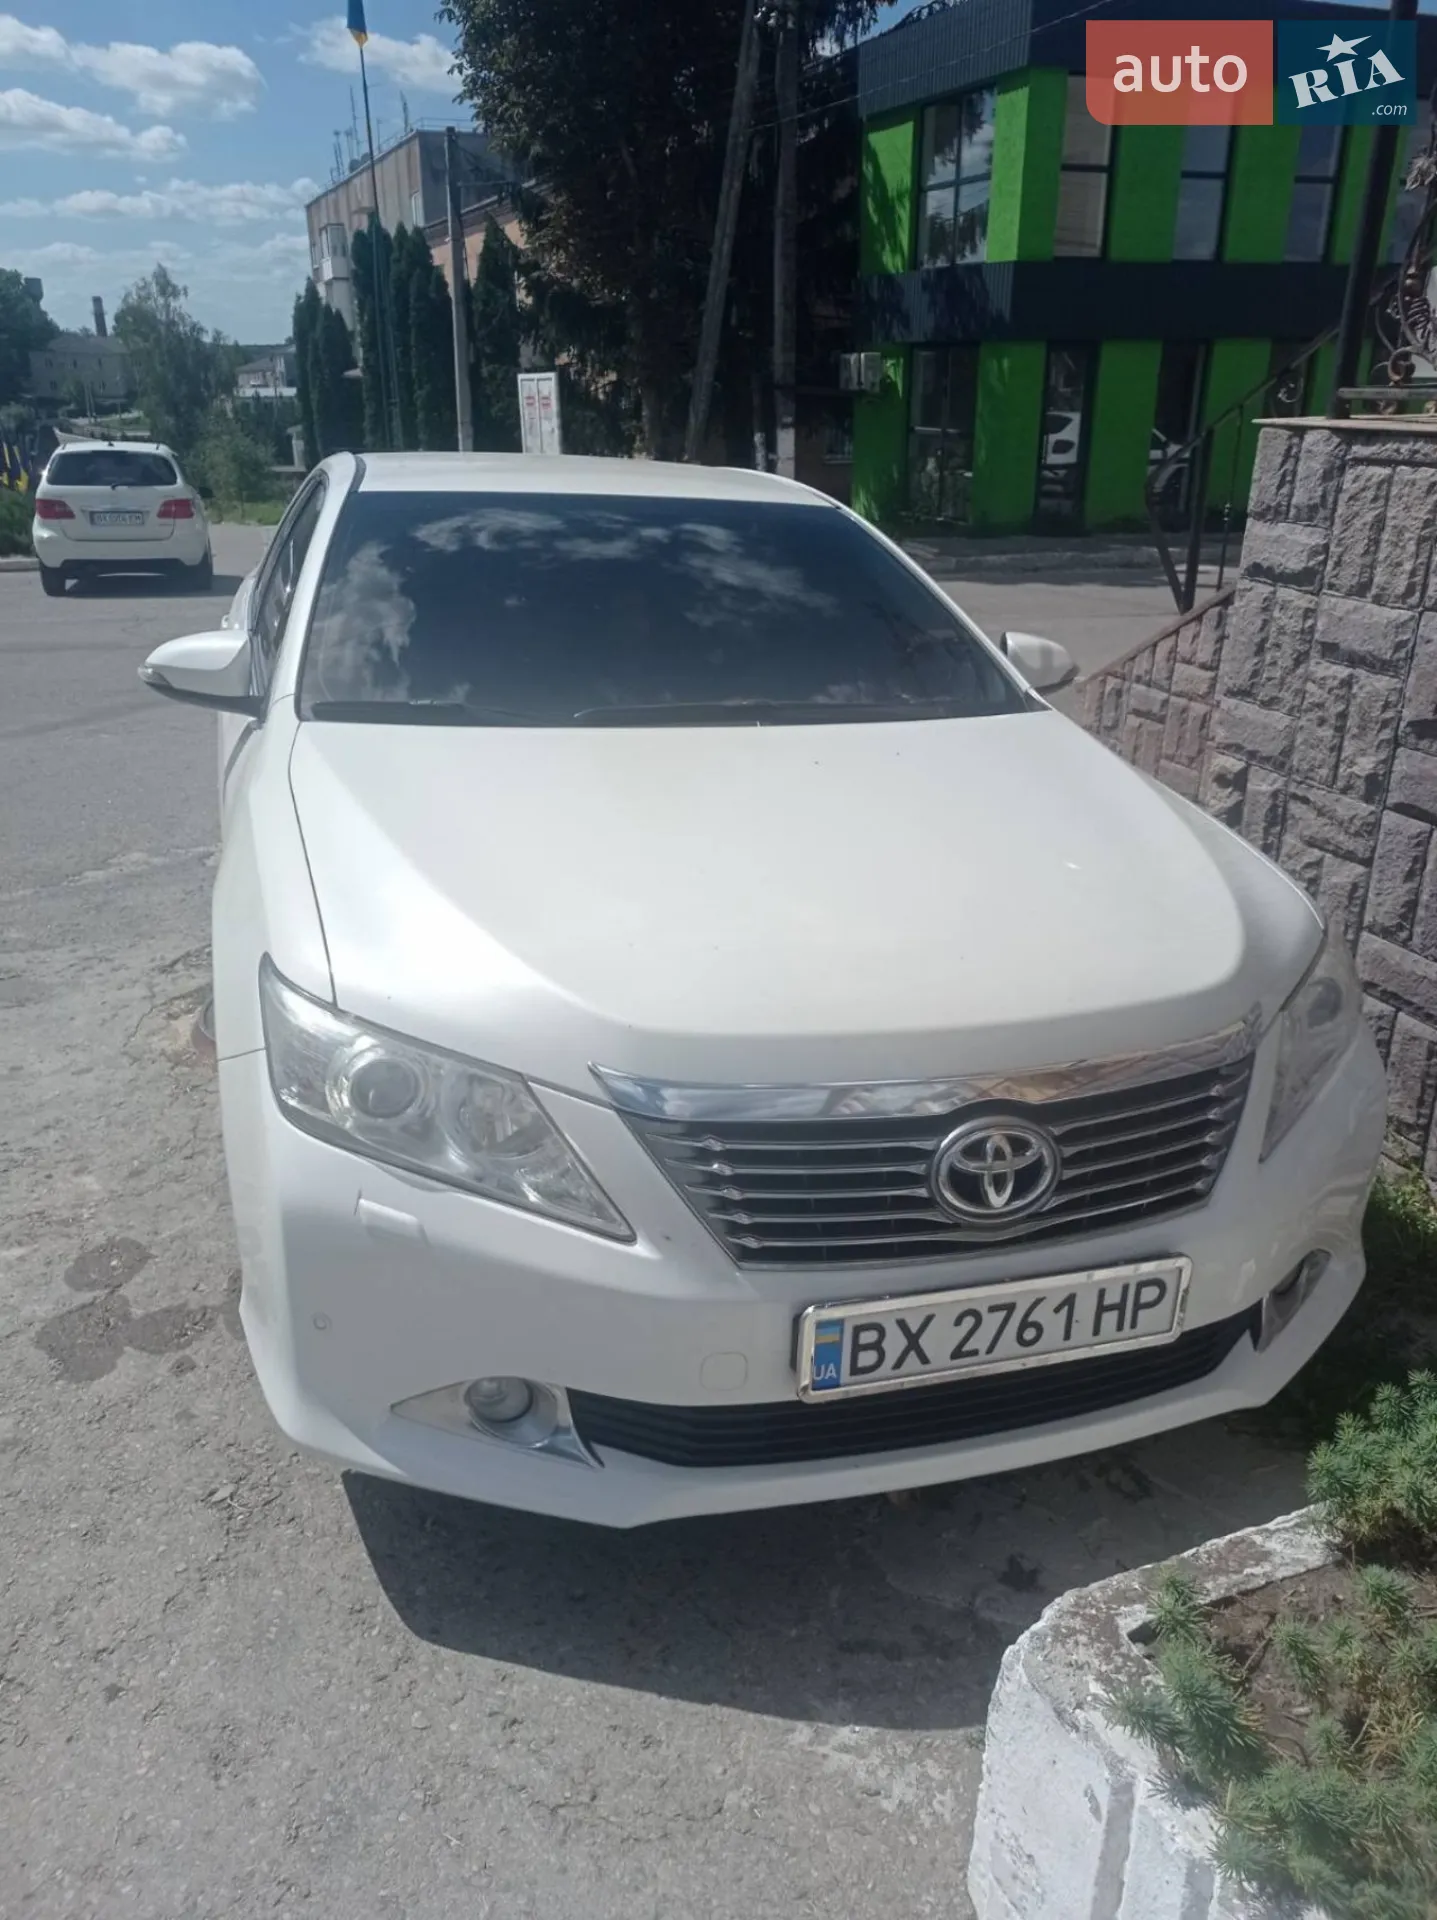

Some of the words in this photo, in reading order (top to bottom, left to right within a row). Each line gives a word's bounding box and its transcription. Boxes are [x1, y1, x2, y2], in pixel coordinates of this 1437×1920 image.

[849, 1314, 936, 1376] BX
[949, 1292, 1078, 1361] 2761
[1092, 1276, 1168, 1337] HP
[812, 1362, 838, 1381] UA
